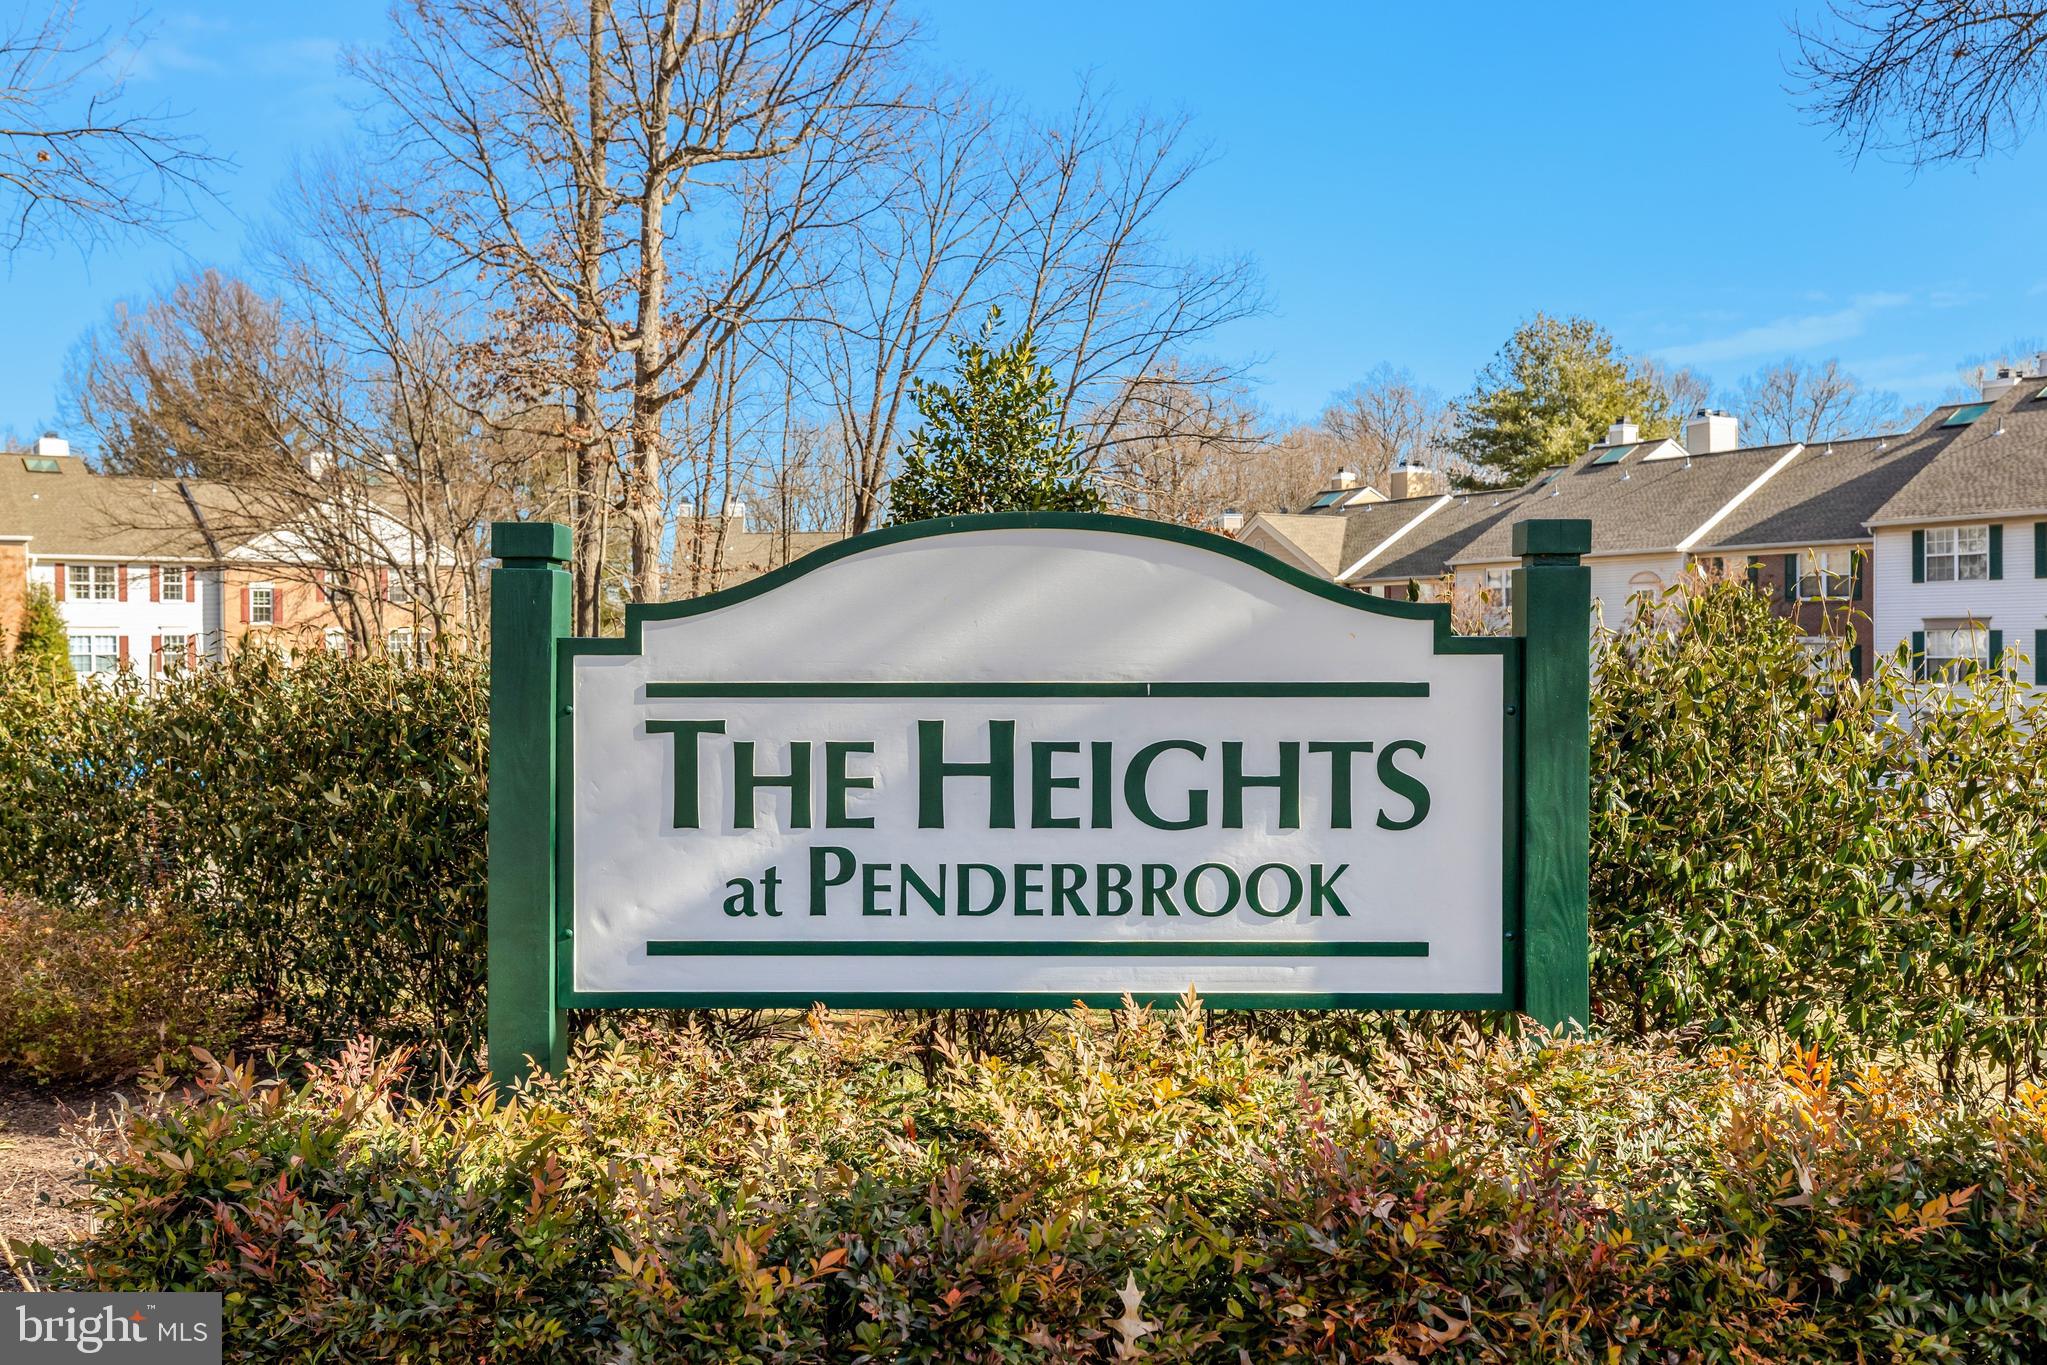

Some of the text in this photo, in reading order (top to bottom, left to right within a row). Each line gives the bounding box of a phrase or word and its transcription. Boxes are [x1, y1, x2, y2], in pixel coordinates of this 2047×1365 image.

[645, 720, 1430, 830] THE HEIGHTS
[723, 847, 1351, 917] at PENDERBROOK
